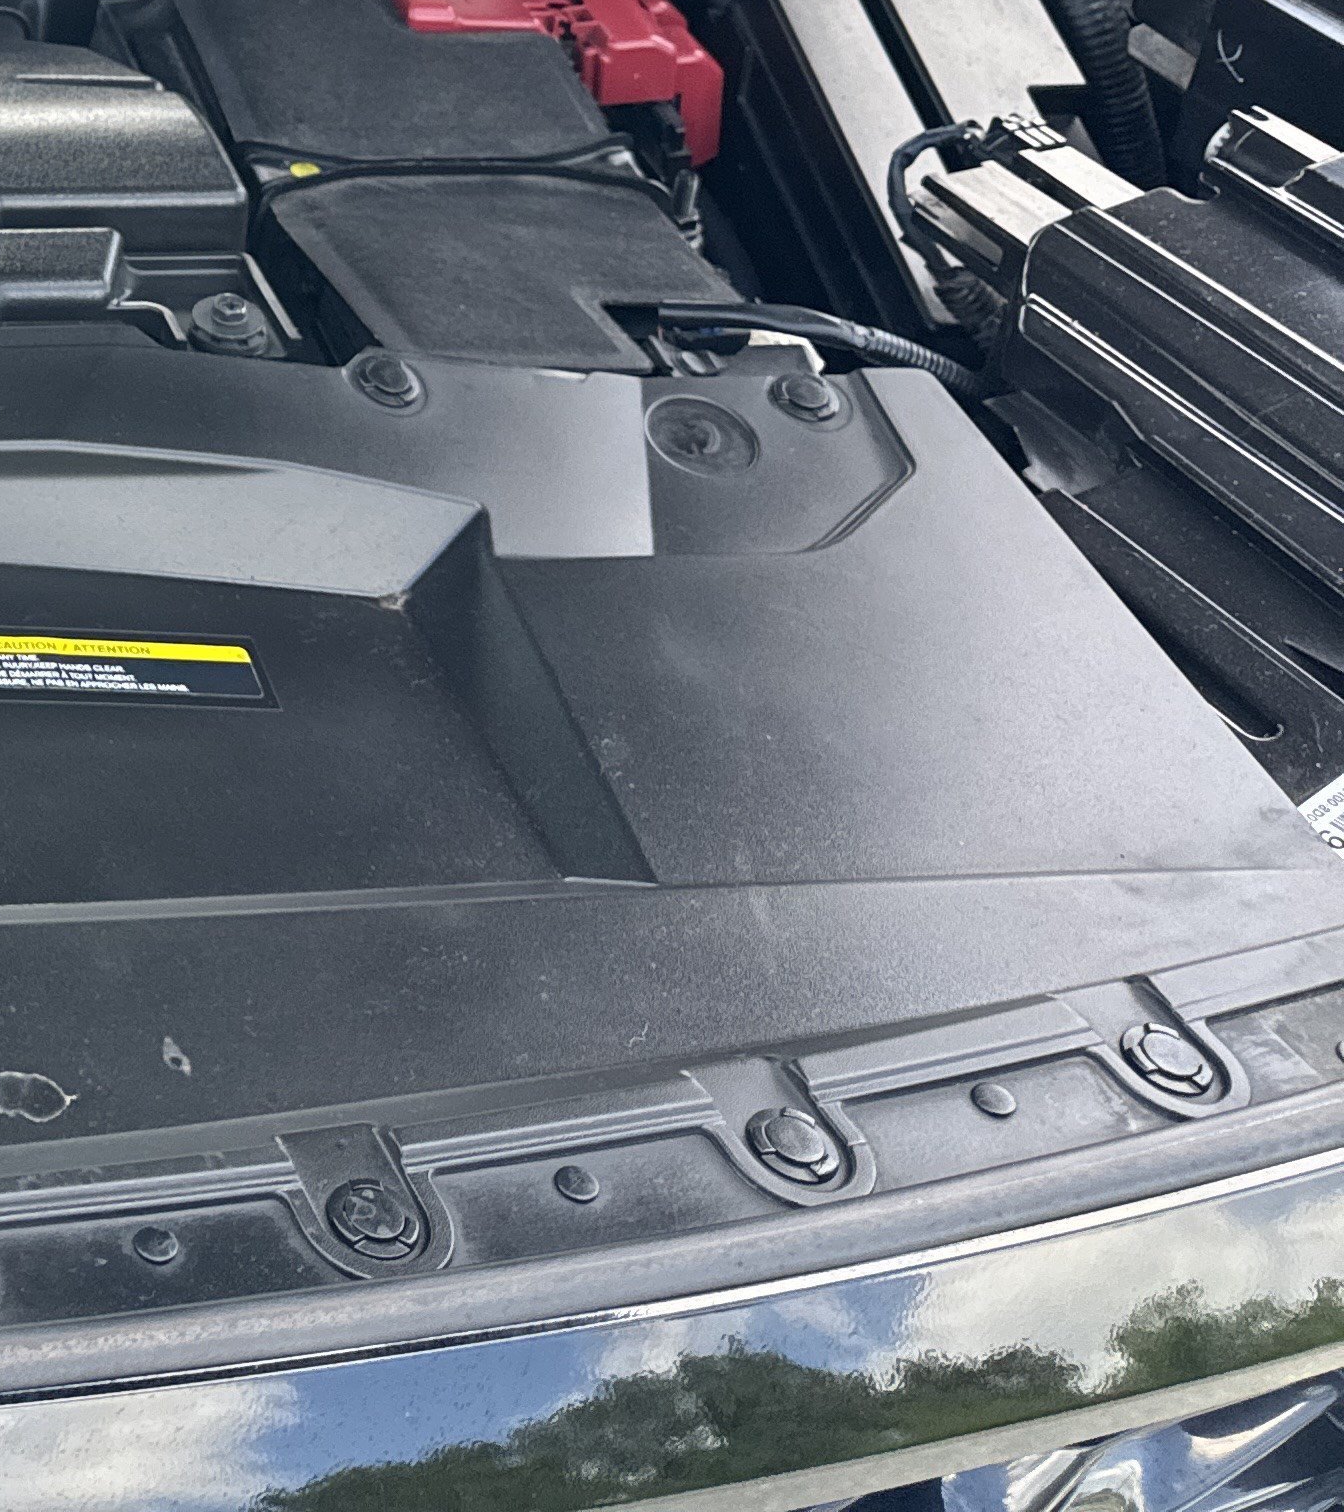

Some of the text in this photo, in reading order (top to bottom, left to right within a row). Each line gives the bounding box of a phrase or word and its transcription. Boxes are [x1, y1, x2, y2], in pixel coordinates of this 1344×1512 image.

[73, 644, 151, 655] ATTENTION
[58, 662, 92, 671] HANDS
[8, 669, 60, 679] DÉMARRER
[69, 672, 93, 680] TOUT
[30, 678, 44, 686] NE
[45, 678, 65, 687] PAS
[65, 679, 79, 687] EN
[80, 680, 138, 690] APPROCHER
